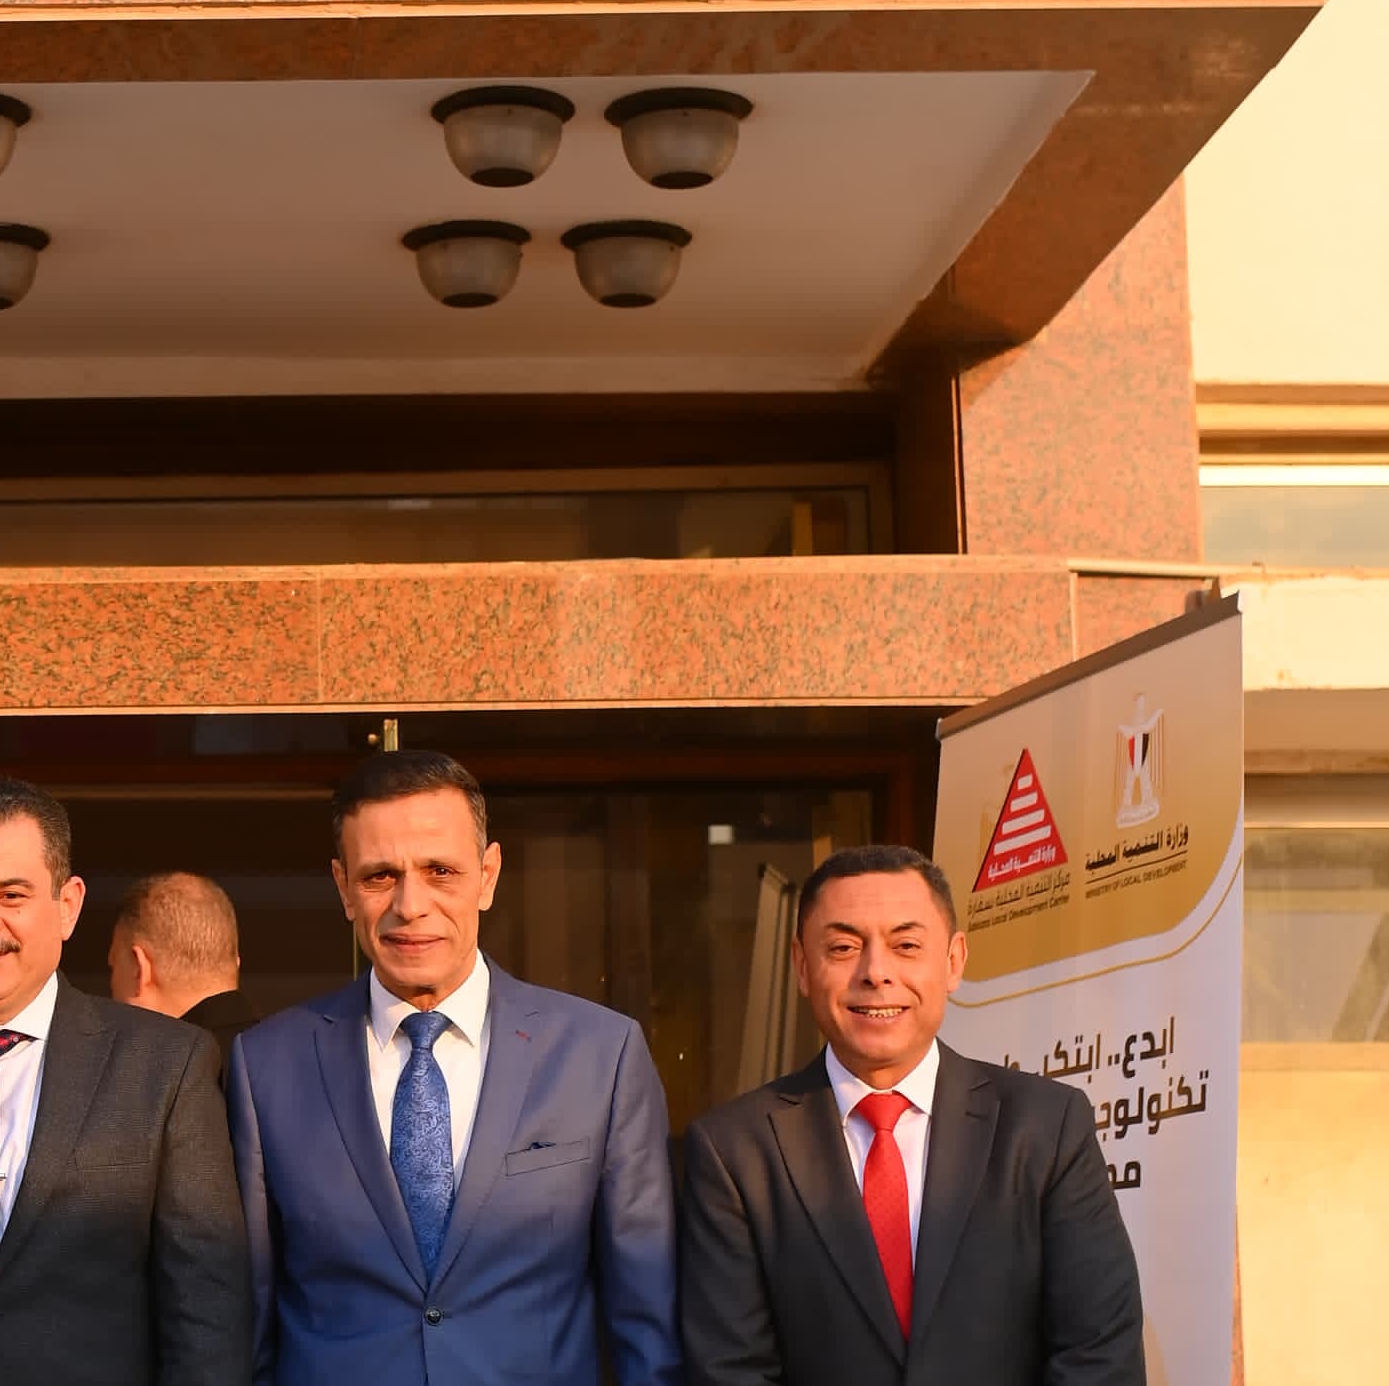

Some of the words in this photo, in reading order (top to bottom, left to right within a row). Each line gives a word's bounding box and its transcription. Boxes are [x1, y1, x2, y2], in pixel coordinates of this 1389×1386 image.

[1122, 829, 1163, 863] التنمية
[1165, 822, 1189, 851] وزارة
[1084, 844, 1120, 875] المحلية
